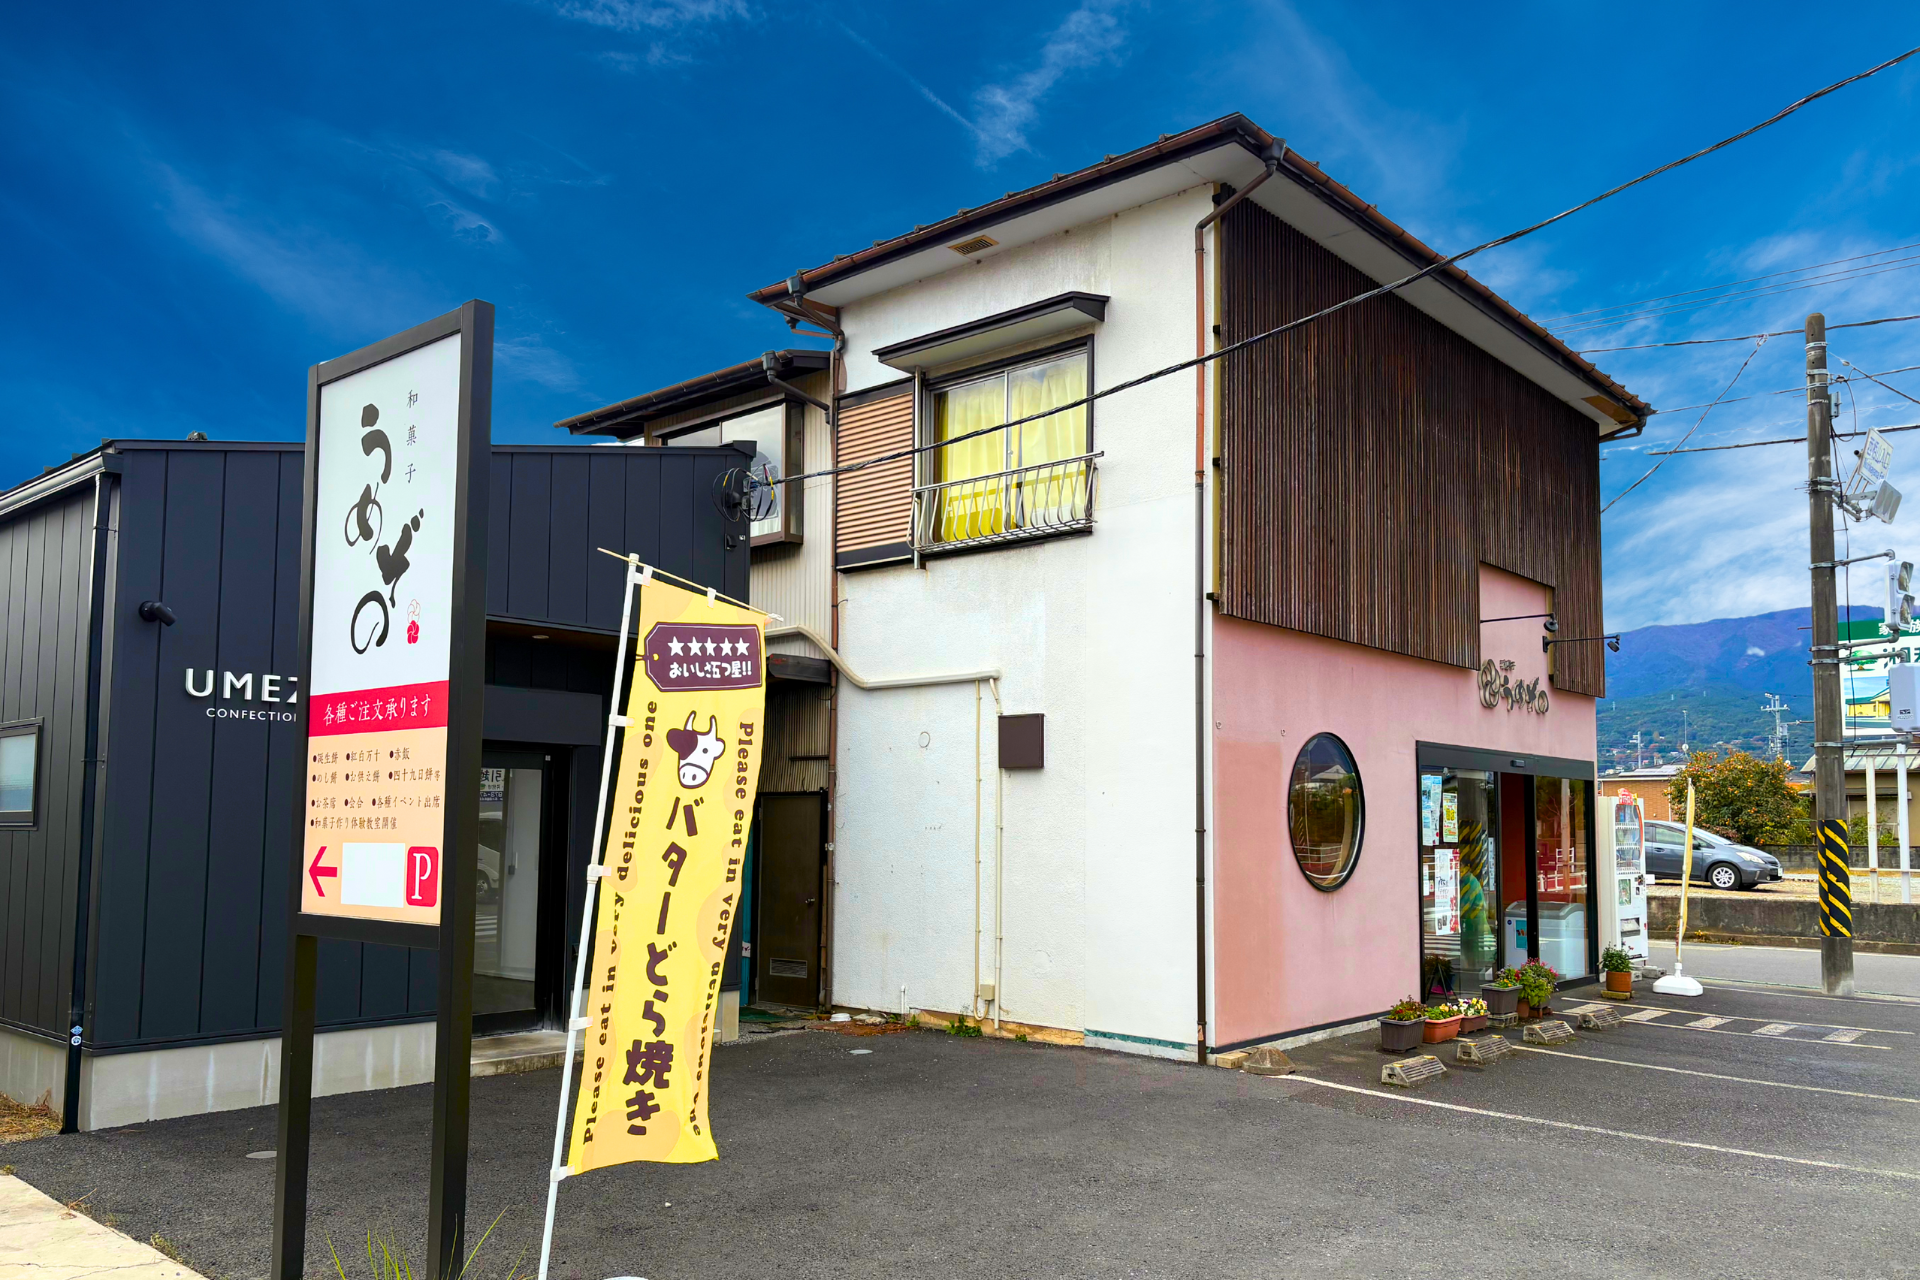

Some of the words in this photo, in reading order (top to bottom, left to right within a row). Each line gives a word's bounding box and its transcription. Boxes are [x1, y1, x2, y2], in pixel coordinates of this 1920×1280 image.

[406, 389, 418, 484] 和菓子
[344, 402, 425, 656] うめぞの
[669, 660, 752, 679] おいしさ五つ星!!
[206, 707, 297, 722] CONFECTIO
[323, 693, 431, 726] 各種ご注文承ります
[643, 700, 657, 748] one
[735, 722, 754, 800] Please
[617, 758, 649, 881] delicious
[731, 808, 744, 848] eat
[411, 852, 432, 900] P
[725, 858, 741, 883] in
[712, 893, 734, 951] very
[602, 964, 617, 993] in
[622, 797, 704, 1136] バターどら焼き
[599, 1002, 612, 1046] eat
[583, 1056, 605, 1145] Please
